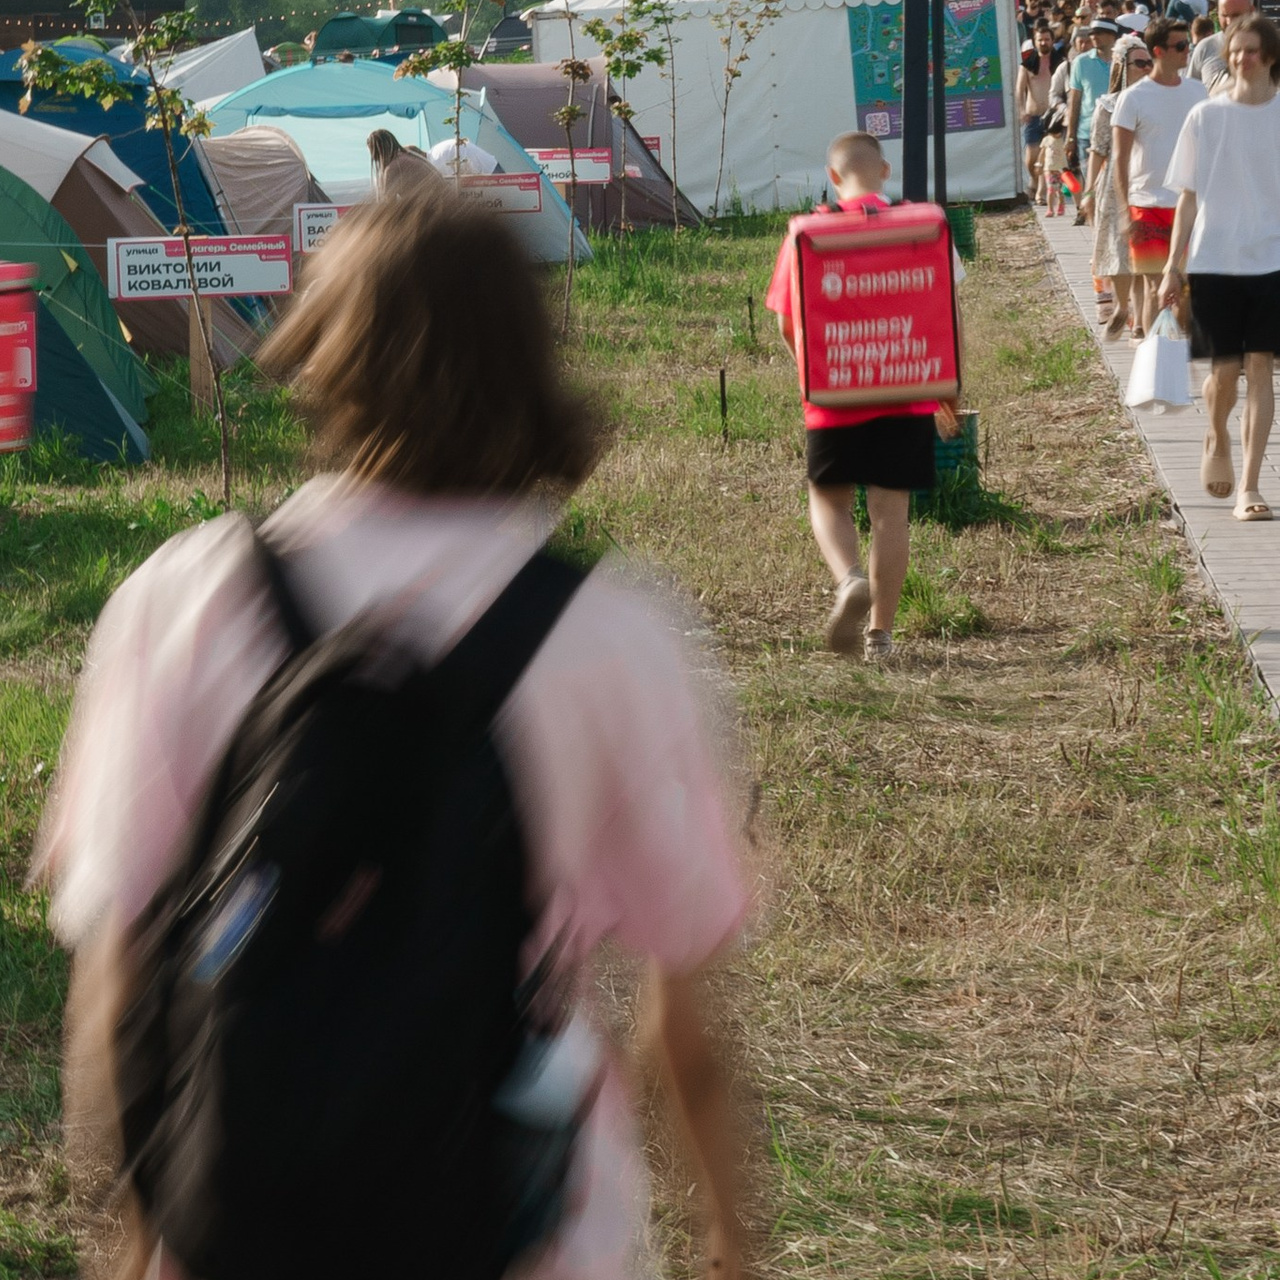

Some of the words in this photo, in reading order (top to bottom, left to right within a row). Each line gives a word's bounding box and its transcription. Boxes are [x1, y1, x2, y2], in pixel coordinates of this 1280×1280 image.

[126, 248, 159, 256] улица
[191, 244, 227, 254] лагерь
[229, 240, 286, 252] Семейный
